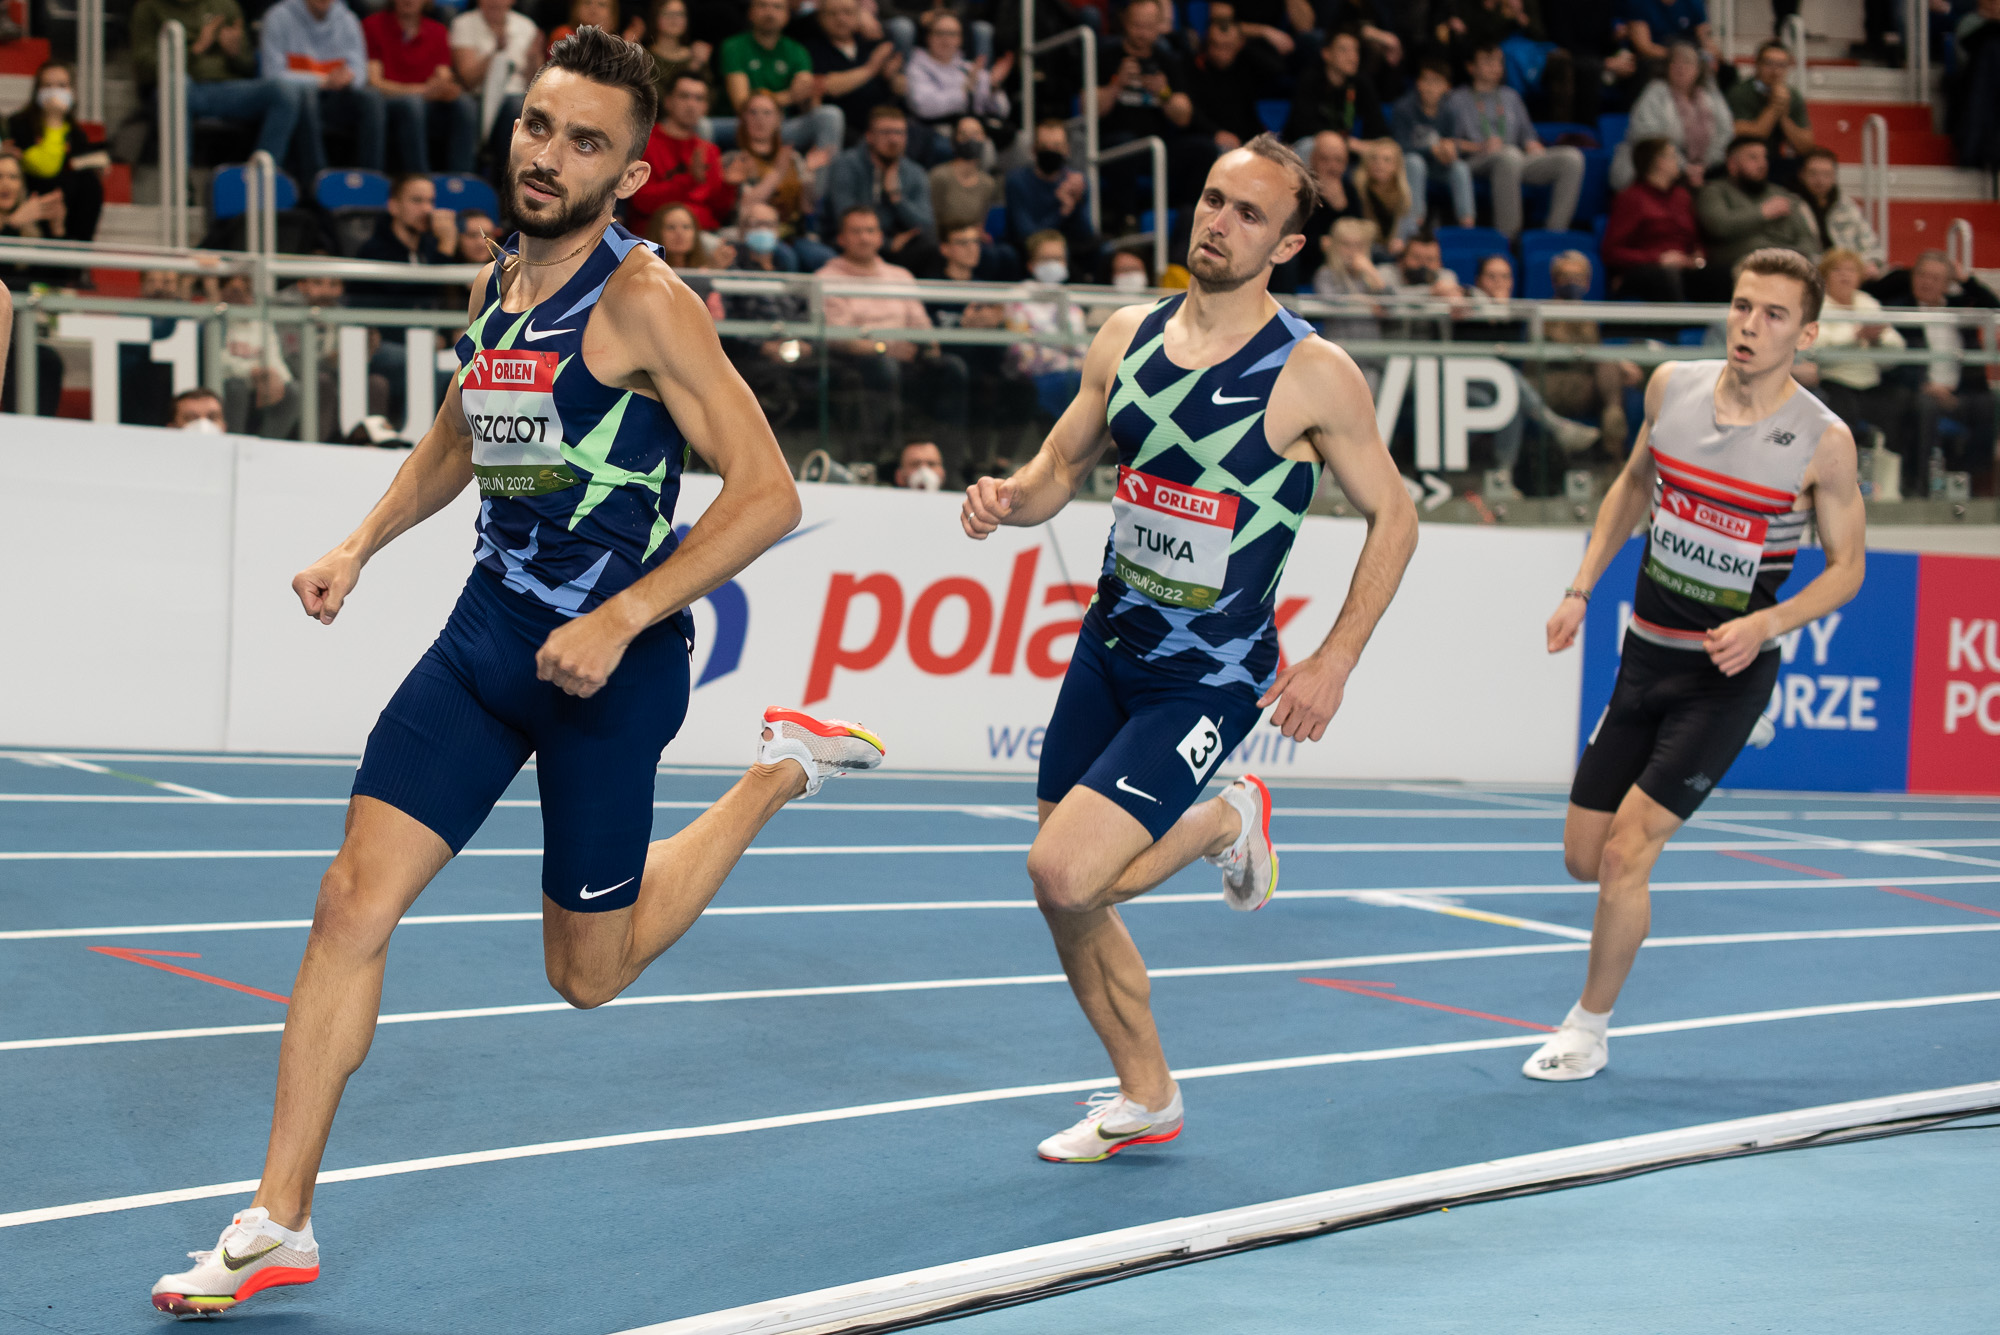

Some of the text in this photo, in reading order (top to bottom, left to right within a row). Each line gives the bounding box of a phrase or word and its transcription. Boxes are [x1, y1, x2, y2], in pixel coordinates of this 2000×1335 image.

[494, 362, 533, 380] ORLEN
[478, 473, 505, 491] ORUŃ
[506, 476, 536, 491] 2022
[1158, 489, 1215, 516] ORLEN
[1699, 509, 1748, 535] ORLEN
[1134, 524, 1195, 563] TUKA
[1653, 525, 1755, 578] LEWALSKI
[1120, 563, 1150, 590] TORUŃ
[1148, 581, 1184, 602] 2022
[1682, 581, 1717, 603] 2022
[1190, 730, 1218, 770] 3
